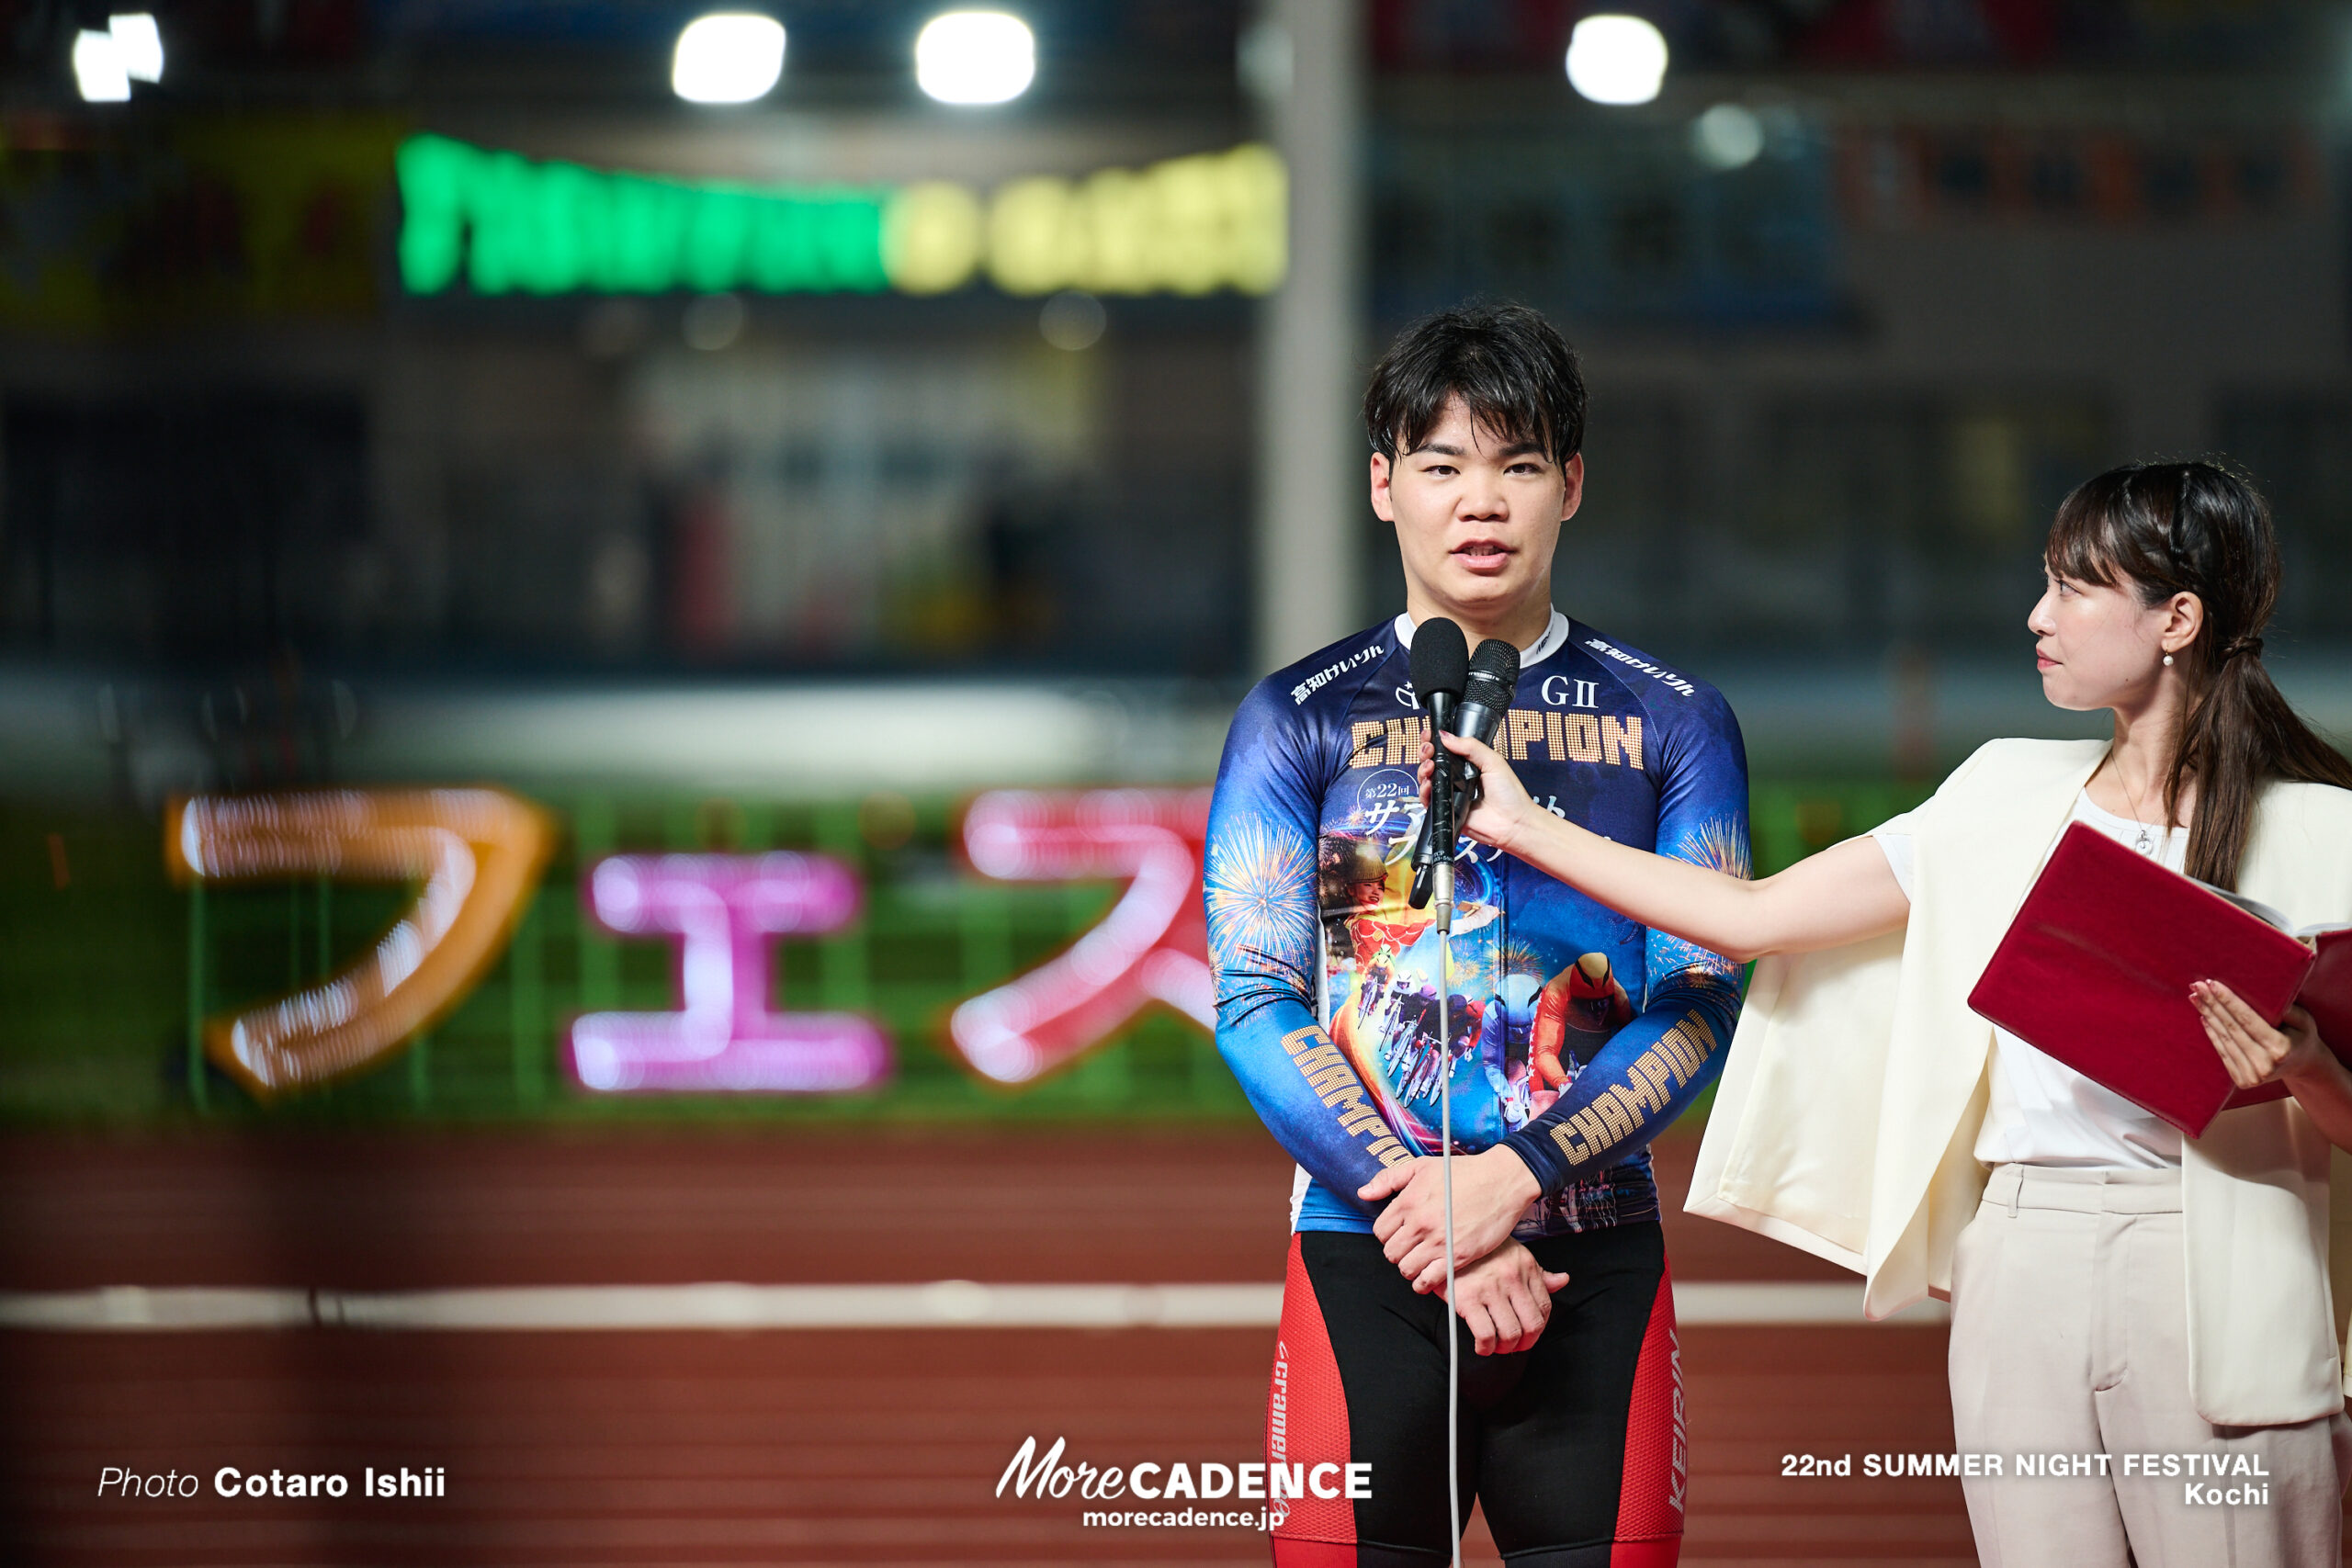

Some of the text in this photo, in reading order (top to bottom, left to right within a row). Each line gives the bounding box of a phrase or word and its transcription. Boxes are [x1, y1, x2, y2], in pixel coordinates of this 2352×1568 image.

[1290, 645, 1385, 705] 高知けいりん
[1585, 638, 1695, 697] 高知けいりん
[1349, 708, 1645, 771] CHPION
[1365, 783, 1410, 799] 第22回
[1281, 1024, 1418, 1168] CHAMPIO
[1549, 1009, 1718, 1167] CHAMPION
[1668, 1328, 1688, 1515] KEIRIN
